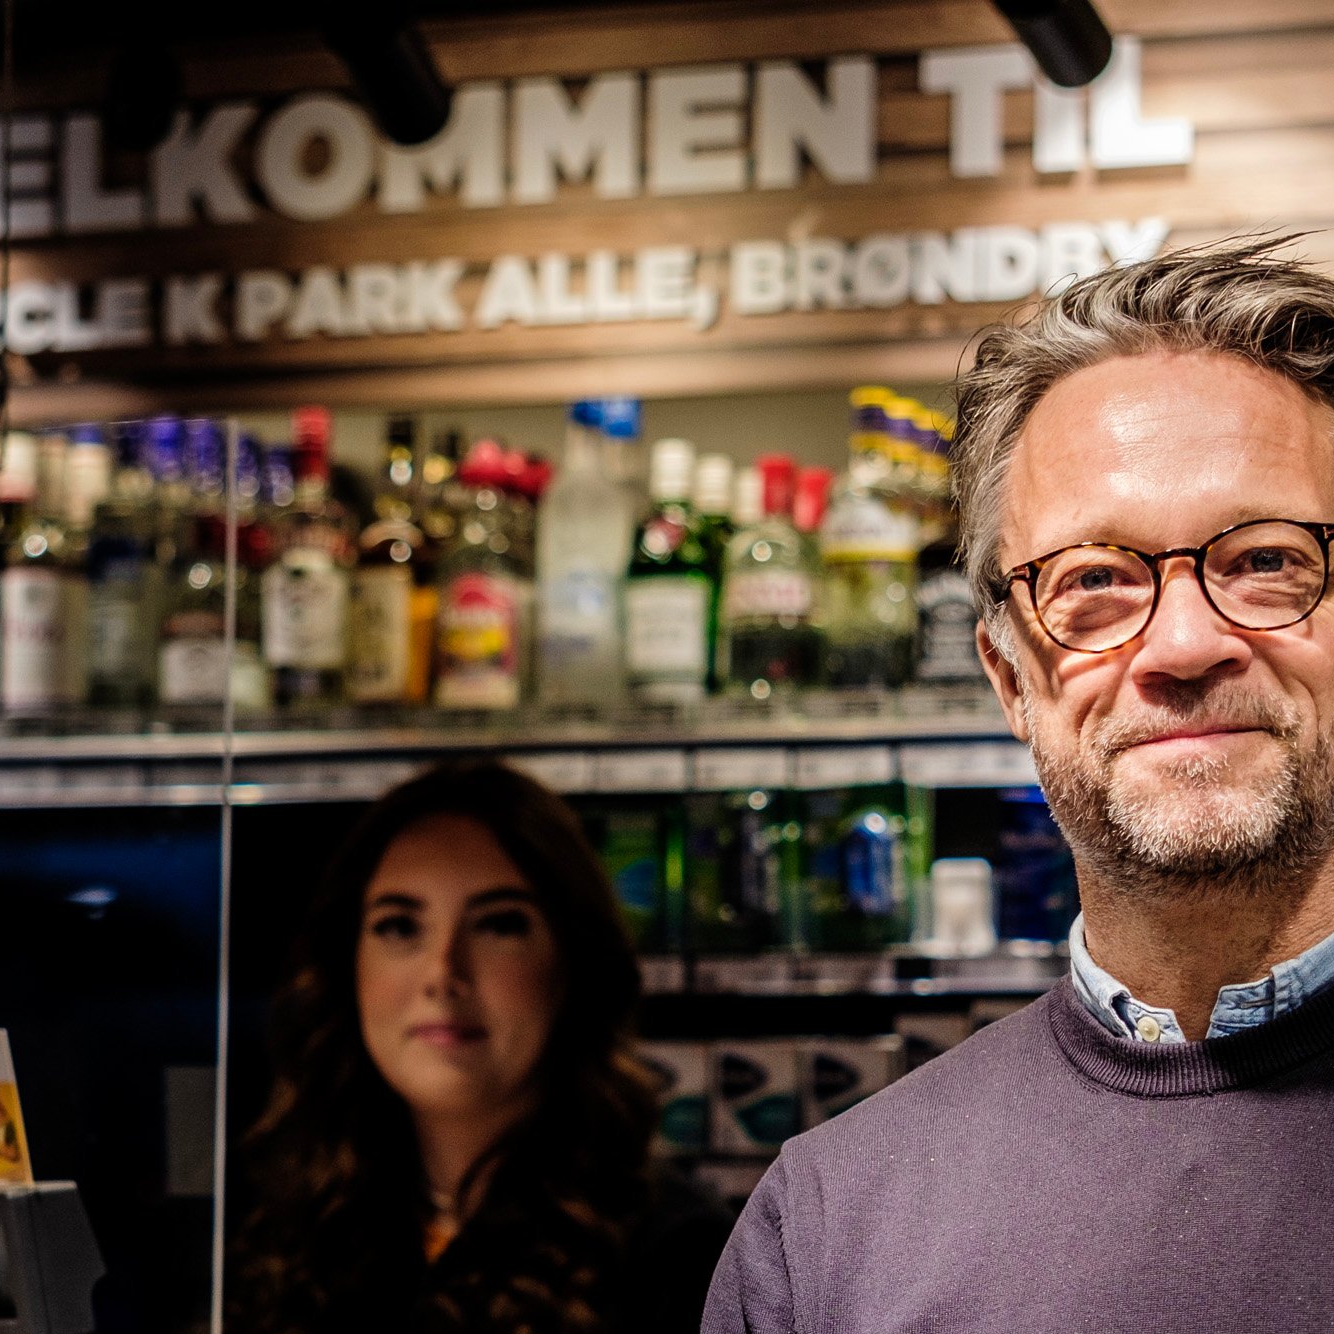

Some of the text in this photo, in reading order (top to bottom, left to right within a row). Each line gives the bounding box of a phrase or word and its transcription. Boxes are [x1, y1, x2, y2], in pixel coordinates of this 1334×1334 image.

[919, 33, 1194, 178] TIL
[163, 274, 227, 344] K
[231, 256, 465, 344] PARK
[473, 244, 720, 330] ALLE,
[731, 214, 1171, 316] BRØNDBY
